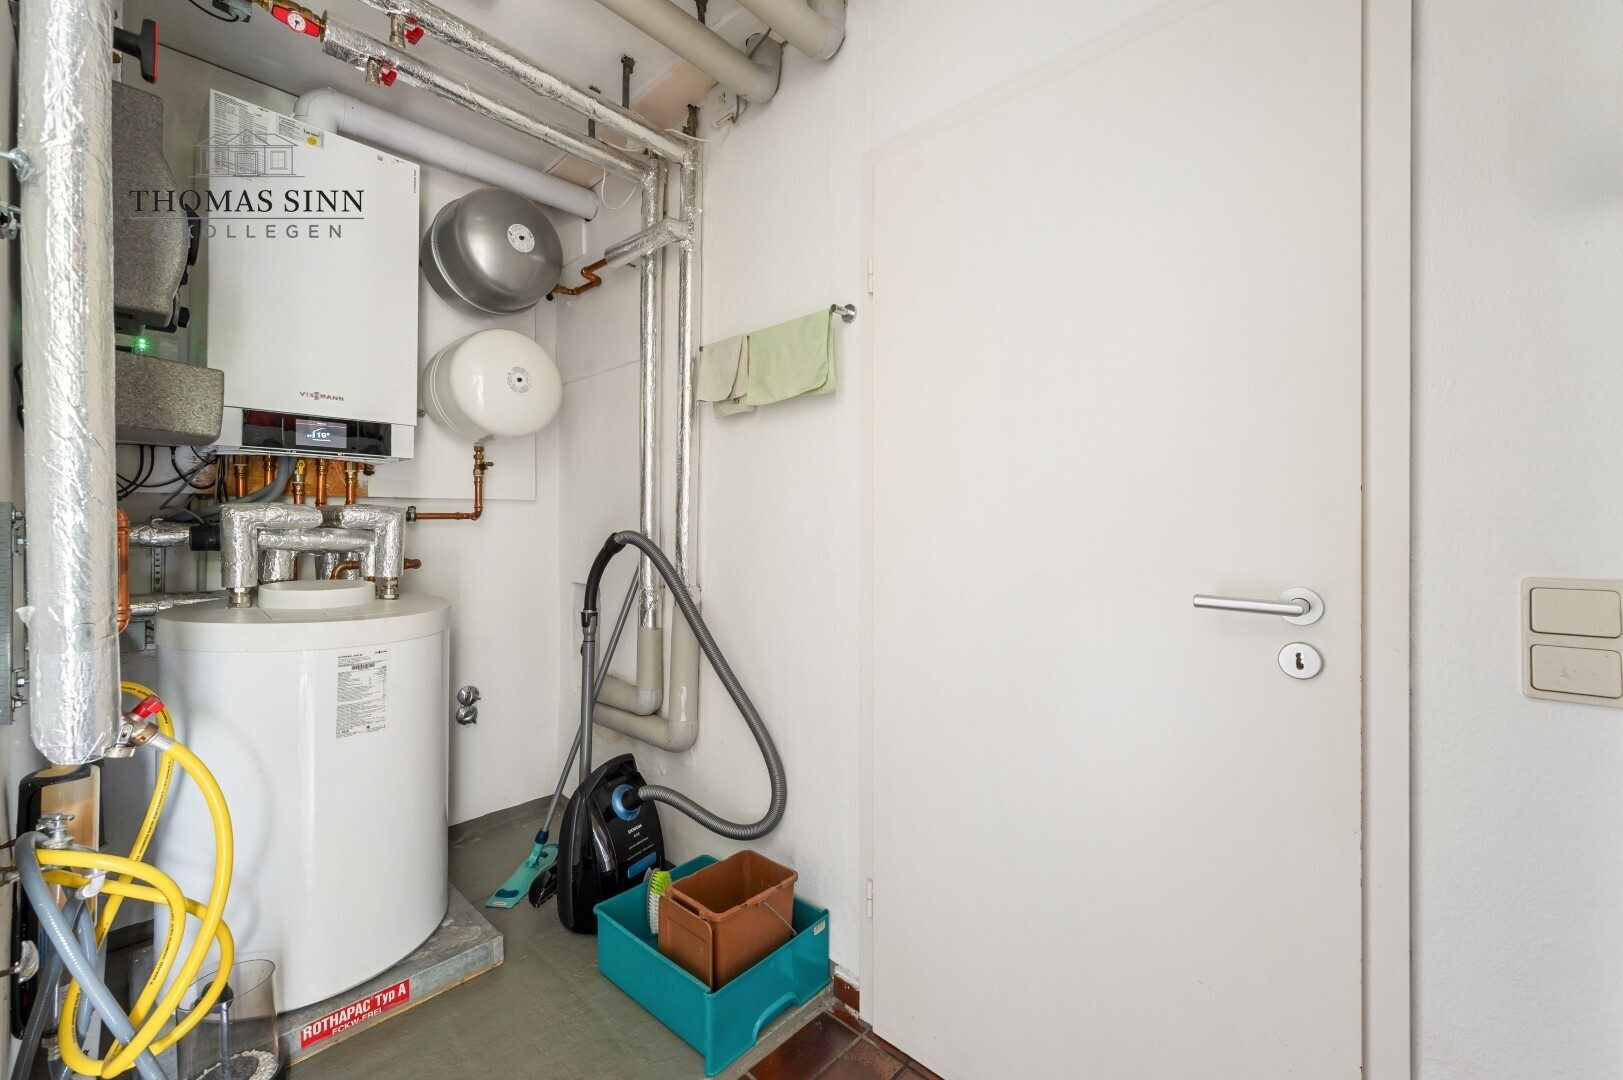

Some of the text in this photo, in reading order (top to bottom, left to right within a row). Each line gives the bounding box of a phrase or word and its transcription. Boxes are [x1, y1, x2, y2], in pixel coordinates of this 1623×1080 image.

[303, 982, 407, 1042] ROTHAPAC Typ A
